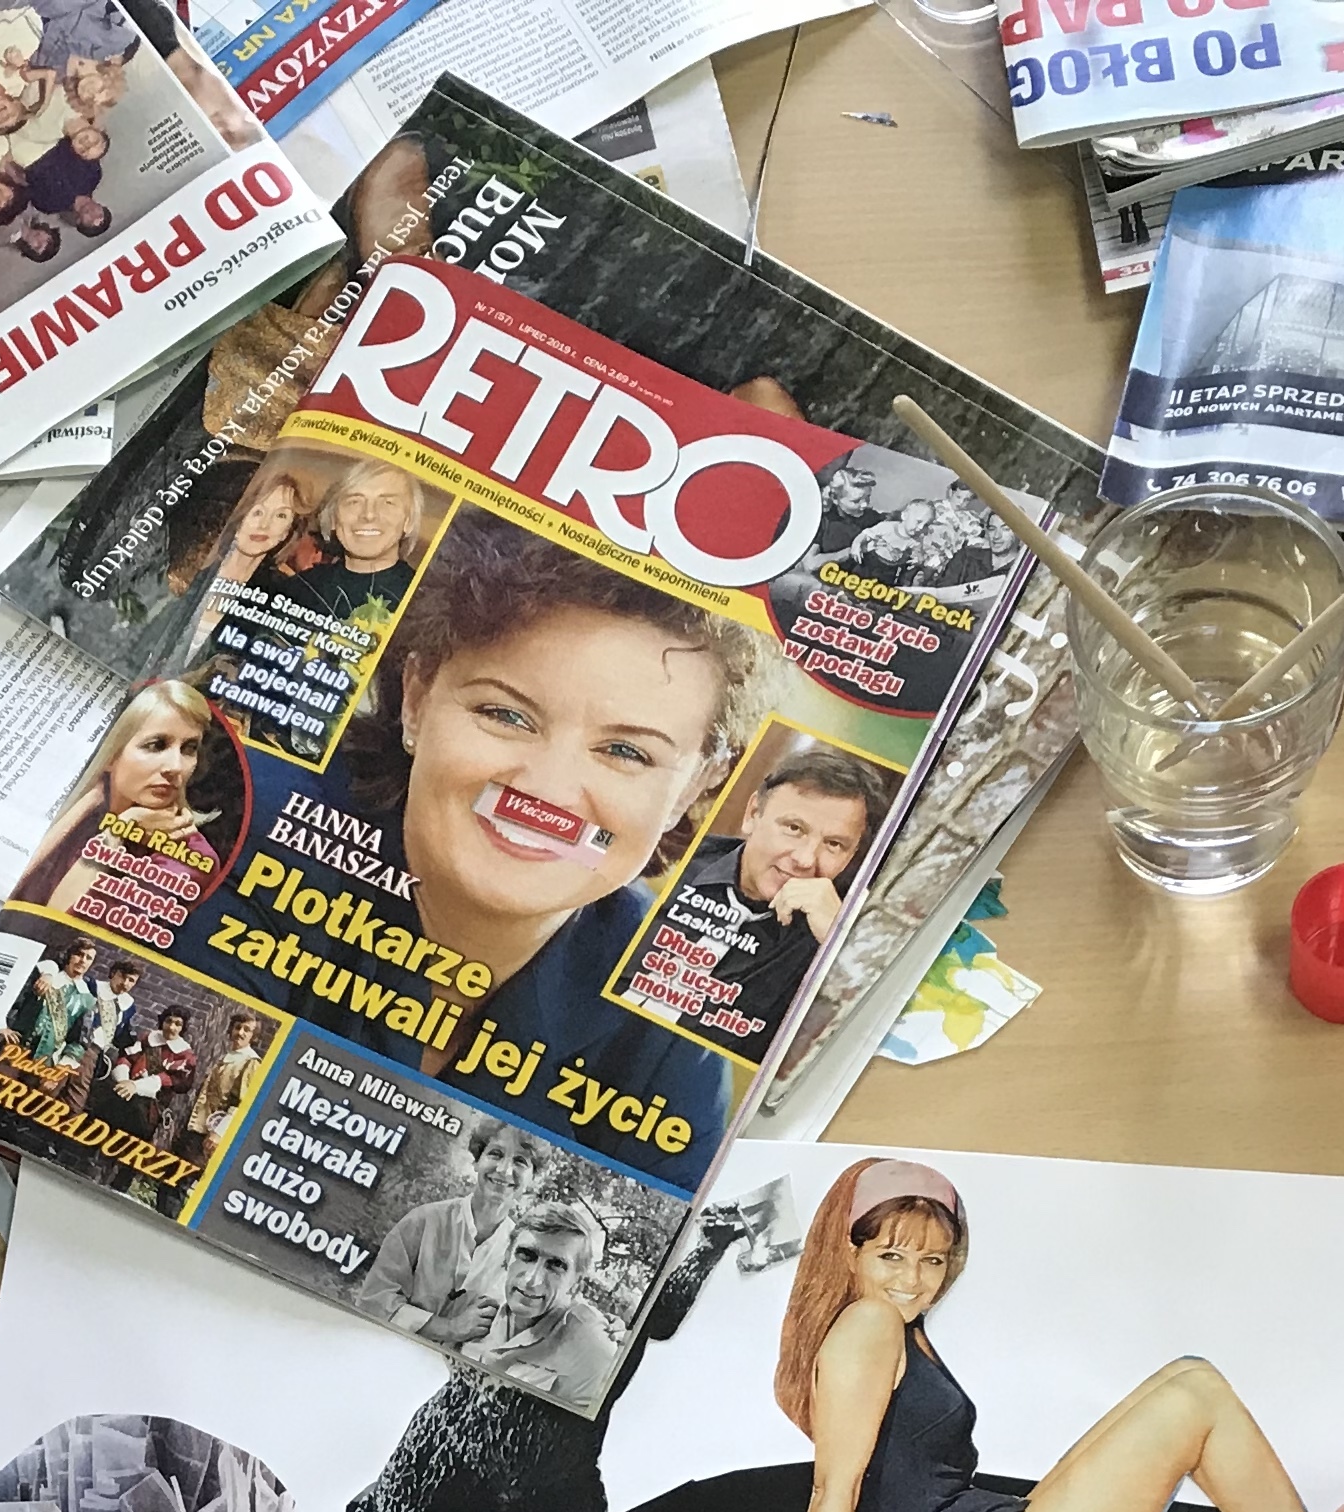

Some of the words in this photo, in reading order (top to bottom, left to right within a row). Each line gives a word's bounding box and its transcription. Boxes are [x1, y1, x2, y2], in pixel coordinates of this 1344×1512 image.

[229, 22, 277, 64] NR
[1005, 36, 1176, 108] BŁOG
[1190, 22, 1282, 78] PO
[203, 159, 296, 242] OD
[417, 148, 476, 213] Teatr
[381, 200, 429, 250] jest
[422, 170, 524, 282] Buc
[302, 276, 366, 349] dobra
[474, 300, 488, 313] Nr
[492, 310, 514, 327] (57)
[517, 322, 547, 343] LIPIEC
[545, 336, 571, 355] 2019
[581, 354, 609, 375] CENA
[229, 338, 313, 424] kolacja,
[1164, 404, 1193, 420] 200
[1198, 398, 1258, 418] NOWYCH
[1168, 389, 1183, 405] II
[1189, 381, 1247, 407] ETAP
[181, 411, 246, 481] którą
[309, 258, 822, 586] RETRO
[154, 468, 196, 512] się
[292, 414, 347, 445] Prawdziwe
[350, 427, 403, 459] gwiazdy
[411, 449, 464, 485] Wielkie
[461, 474, 547, 528] namiętności
[555, 519, 643, 574] Nostalgiczne
[641, 559, 732, 607] wspomnienia
[1170, 474, 1196, 488] 74
[1254, 475, 1281, 492] 76
[1286, 480, 1316, 496] 06
[70, 496, 169, 606] delektuję
[216, 590, 312, 650] Włodzimierz
[312, 630, 363, 666] Korcz
[269, 589, 373, 651] Starostecka
[804, 586, 874, 633] Stare
[874, 609, 944, 659] życie
[816, 556, 913, 616] Gregory
[914, 592, 977, 634] Peck
[216, 622, 250, 653] Na
[248, 630, 303, 675] swój
[302, 654, 353, 693] ślub
[778, 636, 806, 663] w
[804, 641, 905, 704] pociągu
[790, 607, 897, 671] zostawił
[207, 673, 325, 741] tramwajem
[237, 654, 340, 721] pojechali
[97, 809, 147, 846] Pola
[146, 828, 217, 874] Raksa
[279, 789, 390, 856] HANNA
[81, 830, 204, 906] Świadomie
[263, 814, 424, 903] BANASZAK
[73, 891, 108, 921] na
[104, 903, 177, 952] dobre
[89, 864, 191, 931] zniknęła
[231, 850, 504, 1004] Plotkarze
[675, 882, 743, 926] Zenon
[639, 948, 684, 984] się
[677, 964, 743, 1009] uczył
[650, 924, 722, 973] Długo
[628, 967, 706, 1018] mówić
[202, 905, 468, 1054] zatruwali
[455, 1016, 549, 1101] jej
[546, 1054, 696, 1160] życie
[274, 1074, 410, 1159] Mężowi
[294, 1045, 358, 1089] Anna
[354, 1071, 467, 1138] Milewska
[237, 1145, 327, 1207] dużo
[255, 1112, 383, 1190] dawała
[216, 1183, 373, 1278] swobody
